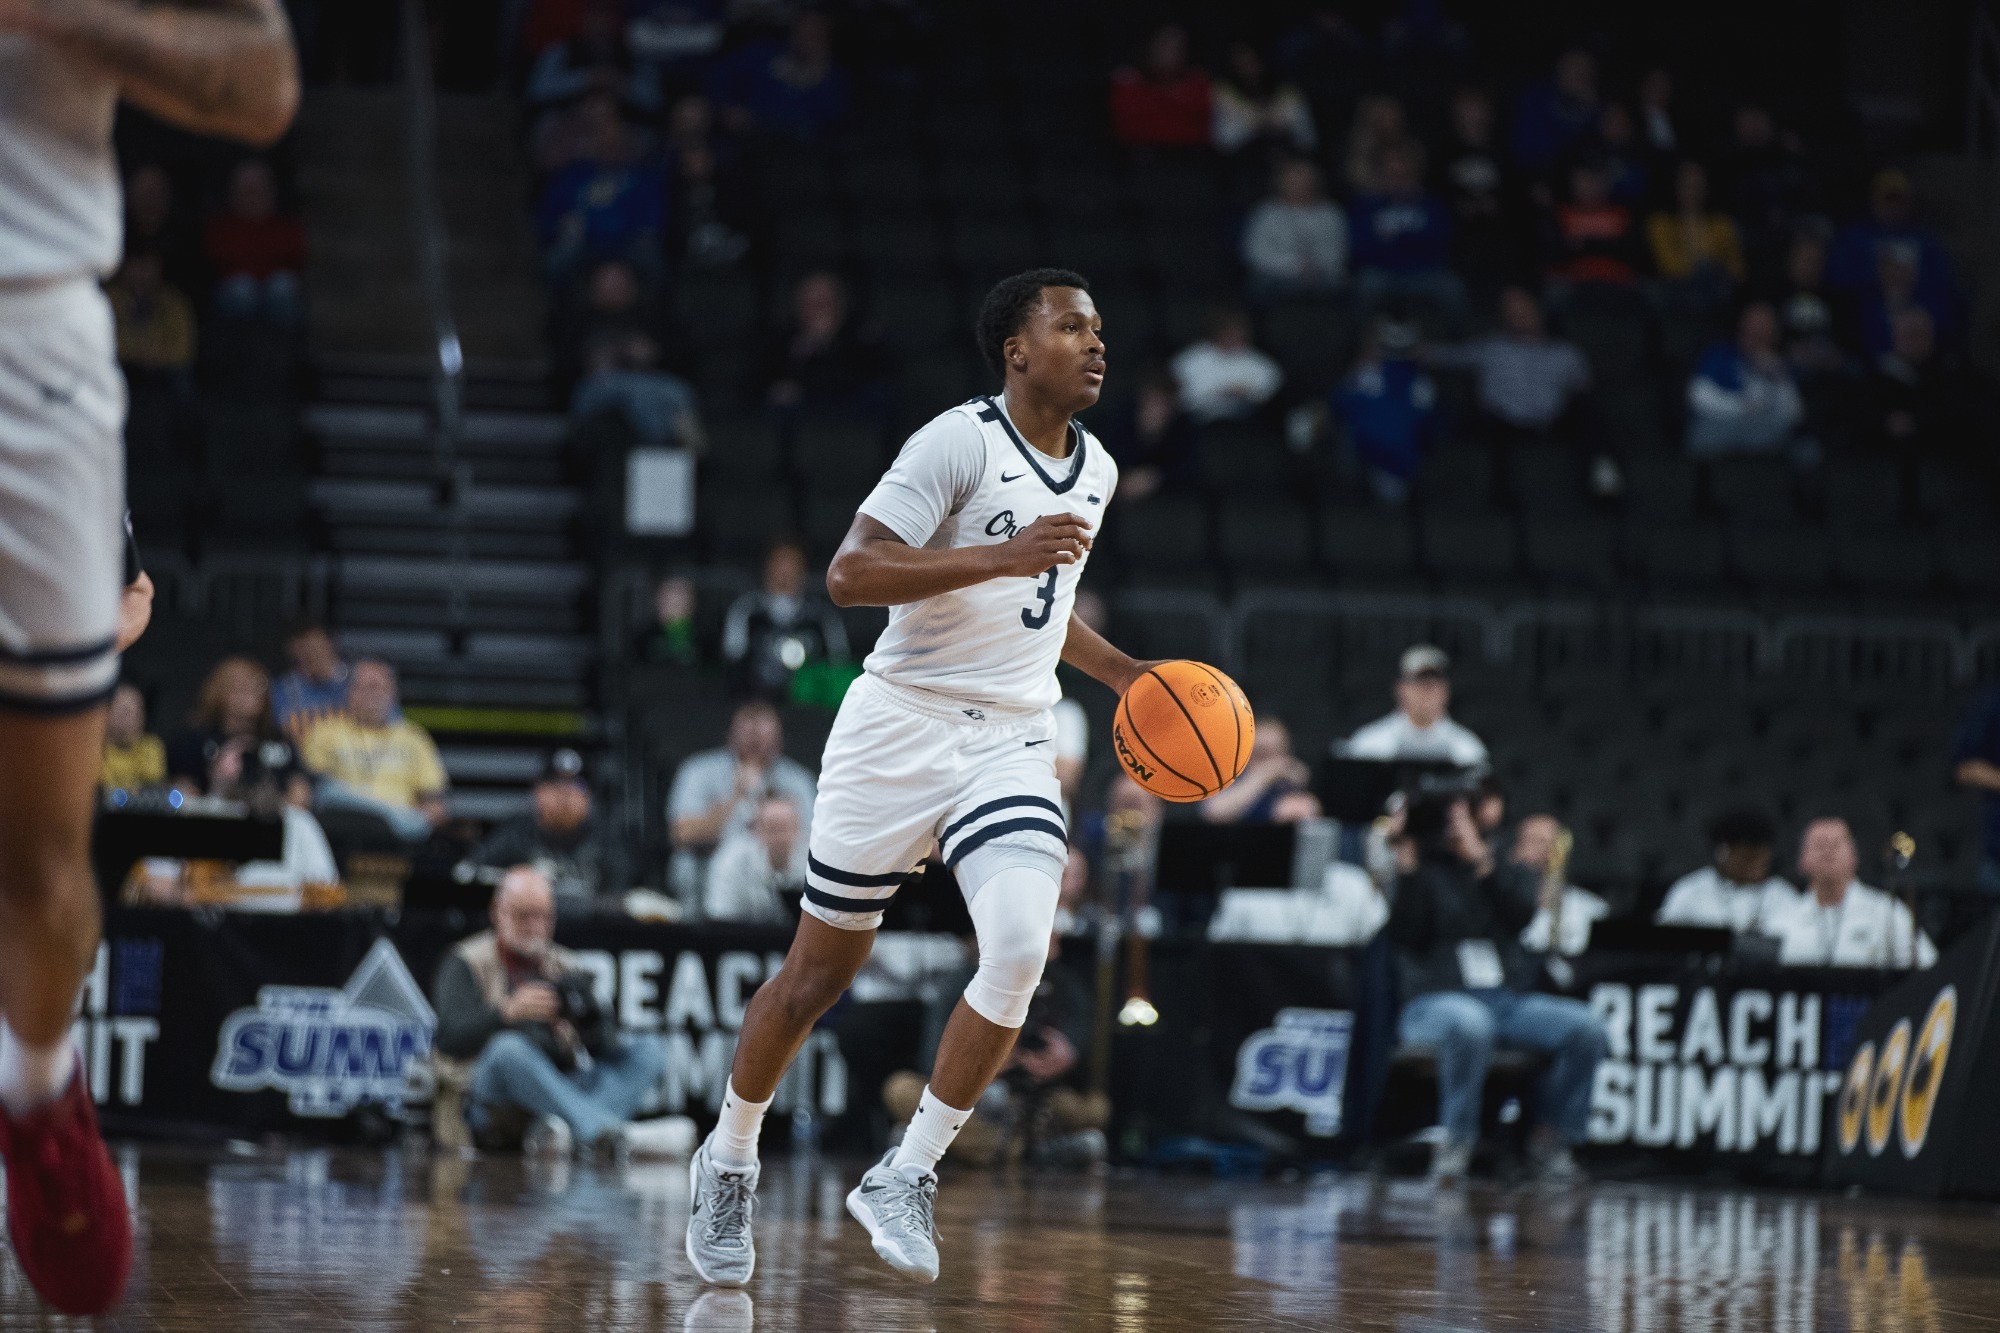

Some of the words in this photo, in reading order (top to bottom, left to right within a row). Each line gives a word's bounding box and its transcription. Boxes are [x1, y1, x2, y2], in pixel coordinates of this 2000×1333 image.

[1021, 564, 1058, 631] 3
[1115, 723, 1154, 782] NCAA
[1586, 1060, 1842, 1155] SUMMI
